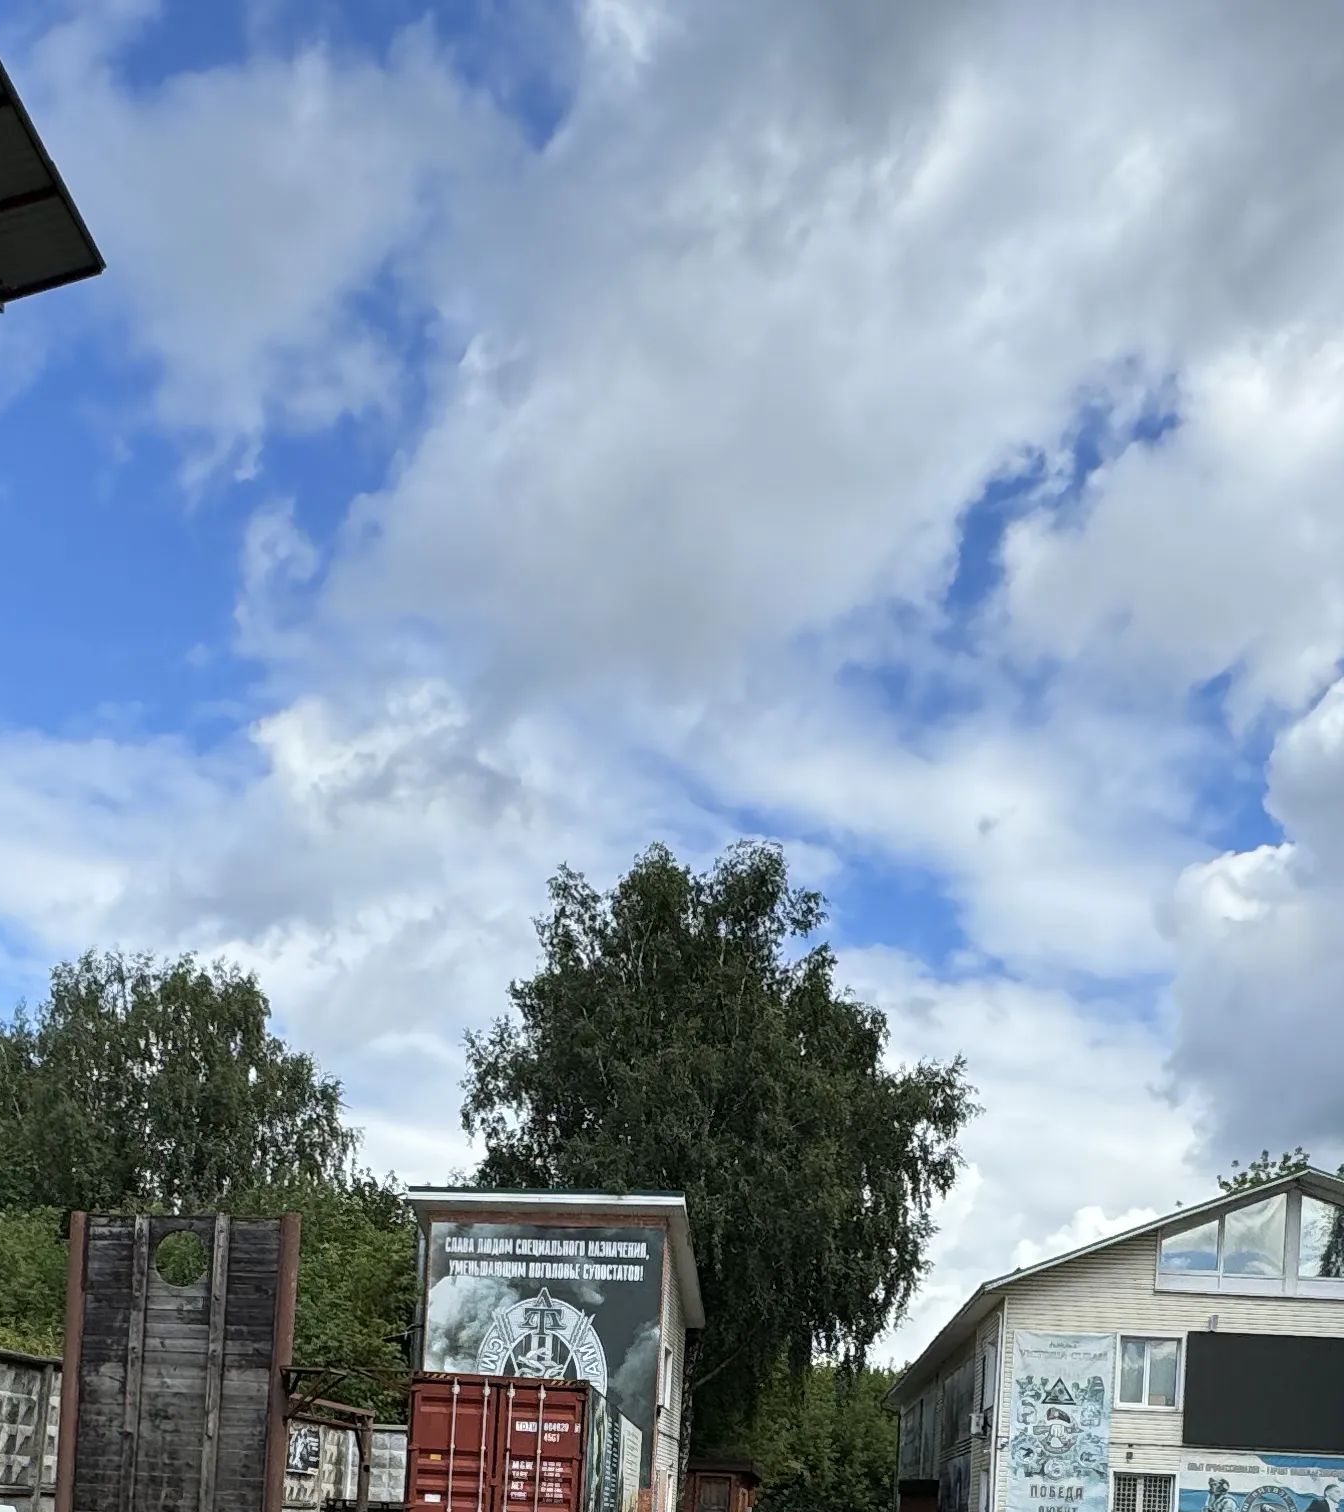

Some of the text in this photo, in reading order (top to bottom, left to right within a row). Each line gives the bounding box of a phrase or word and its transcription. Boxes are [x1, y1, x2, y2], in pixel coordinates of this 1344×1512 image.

[445, 1237, 650, 1260] СЛАВА ЛЮДЯМ СПЕЦИАЛЬНОГО НАЗНАЧЕНИЯ,
[449, 1260, 644, 1282] УМЕНЬШАЮЩИМ ПОГОЛОВЬЕ СУПОСТАТОВ!
[1029, 1484, 1084, 1502] ПОБЕДА
